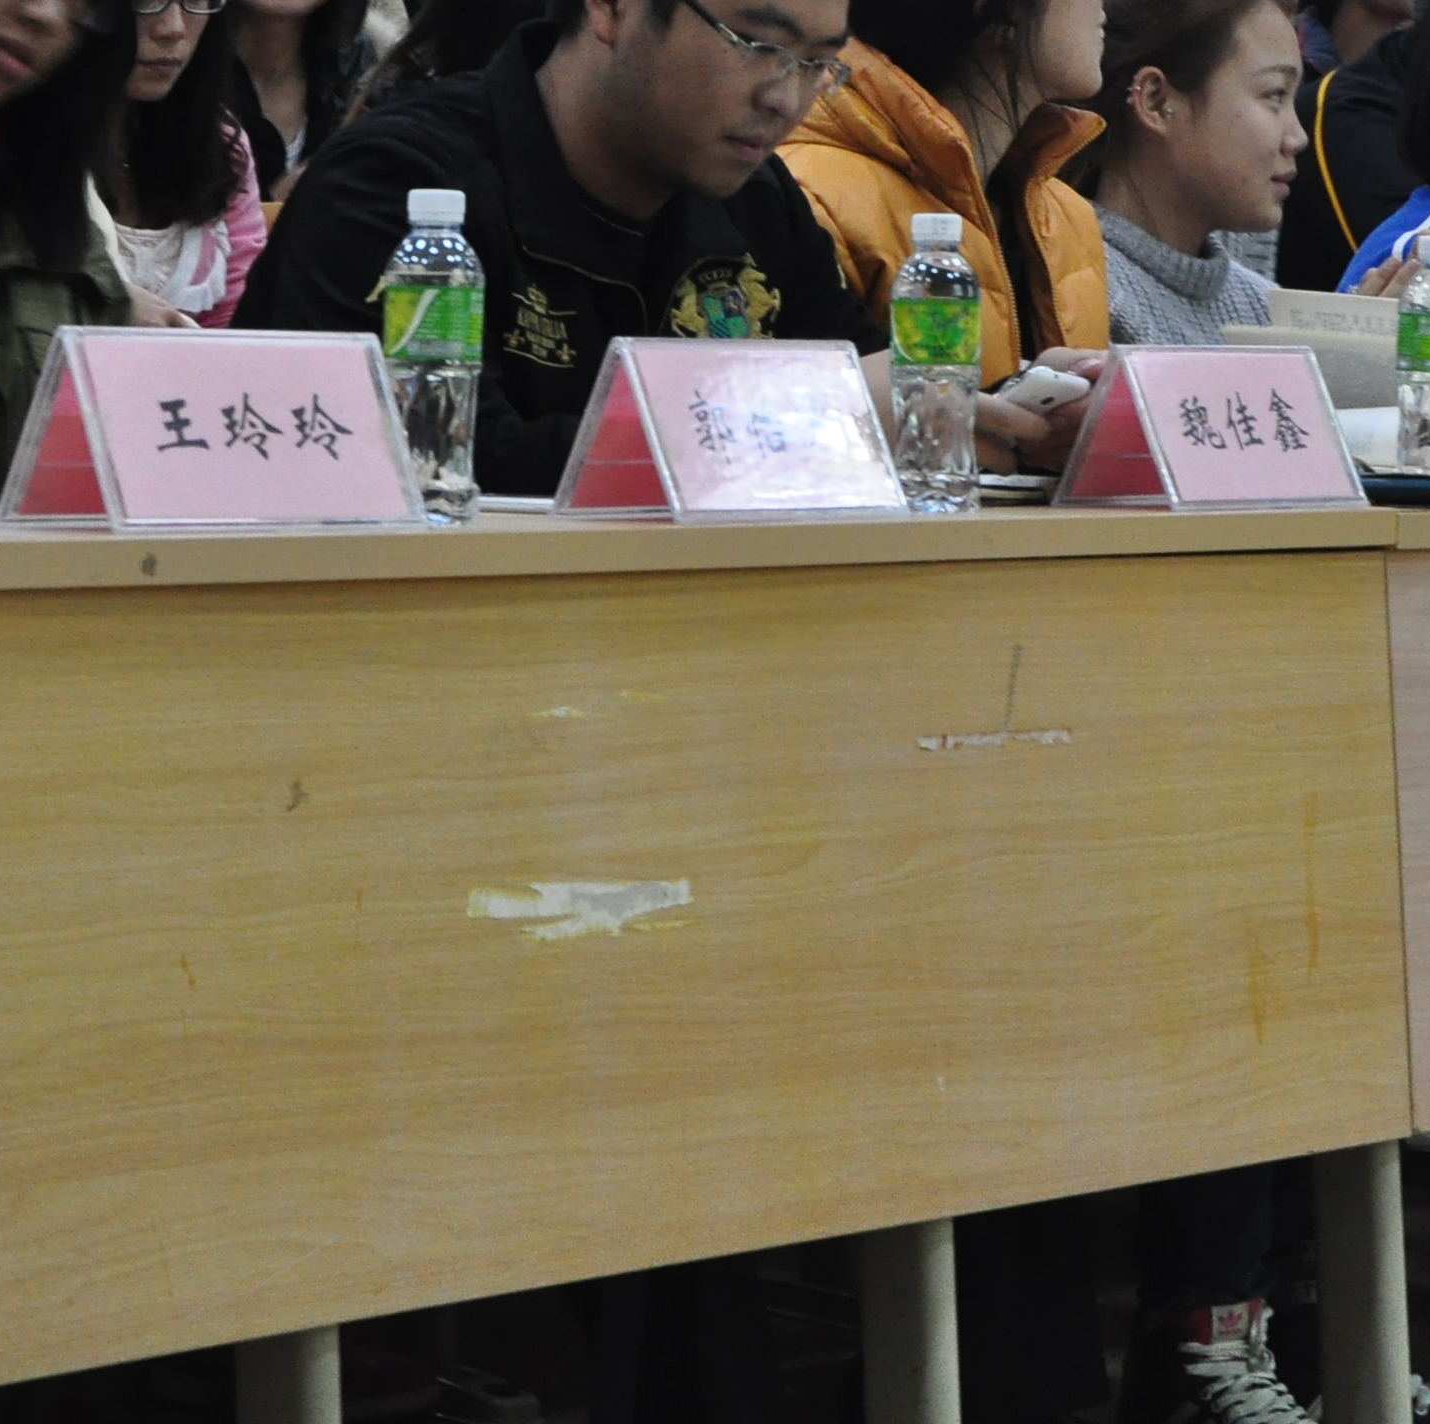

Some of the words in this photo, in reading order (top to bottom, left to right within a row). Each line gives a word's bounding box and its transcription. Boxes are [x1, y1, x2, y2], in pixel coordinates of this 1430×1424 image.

[157, 392, 354, 460] 王玲玲
[1178, 388, 1310, 453] 魏佳鑫
